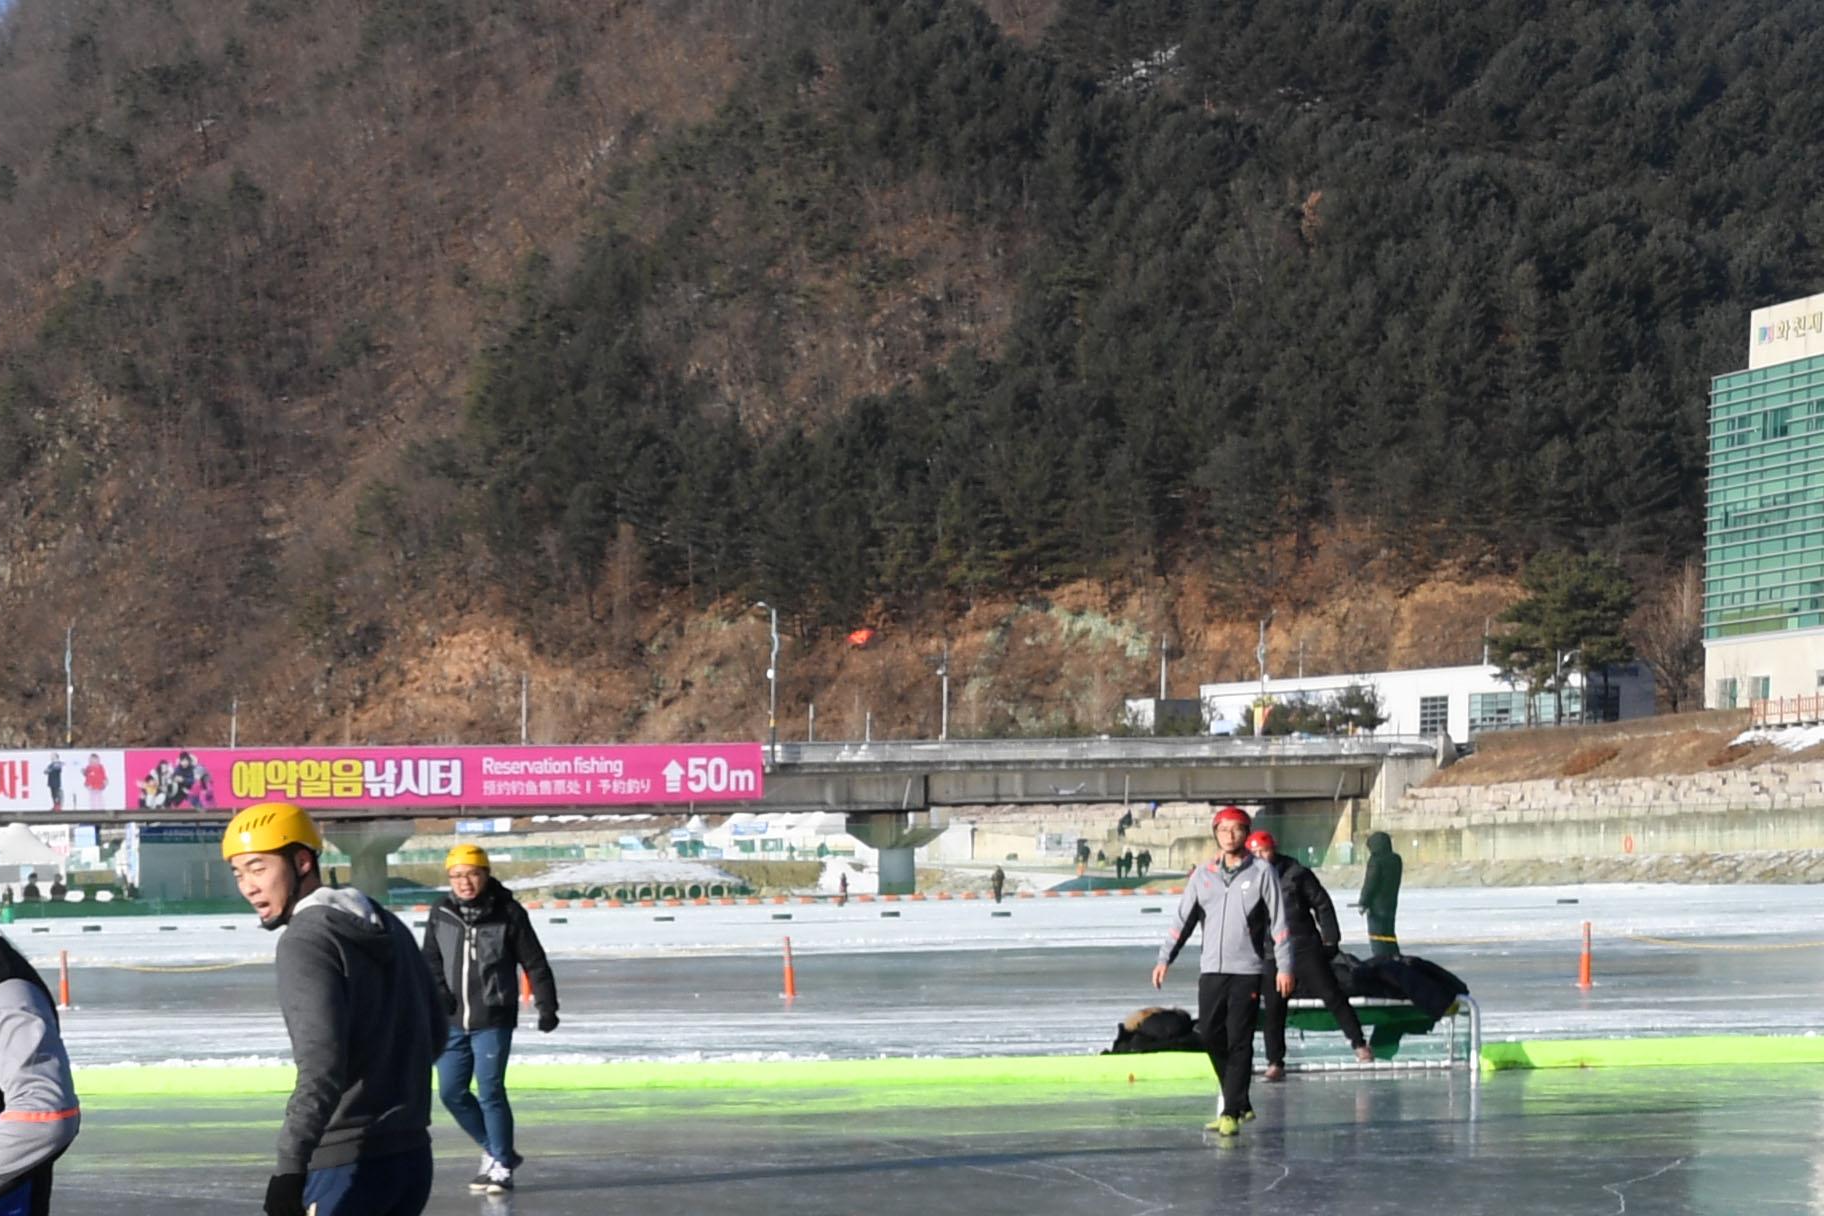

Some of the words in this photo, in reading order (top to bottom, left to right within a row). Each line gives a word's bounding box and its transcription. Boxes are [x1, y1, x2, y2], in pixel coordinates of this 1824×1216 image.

[232, 758, 463, 799] 예약얼음낚시터
[482, 757, 572, 774] Reservation
[573, 756, 624, 778] fishing
[688, 757, 755, 793] 50m
